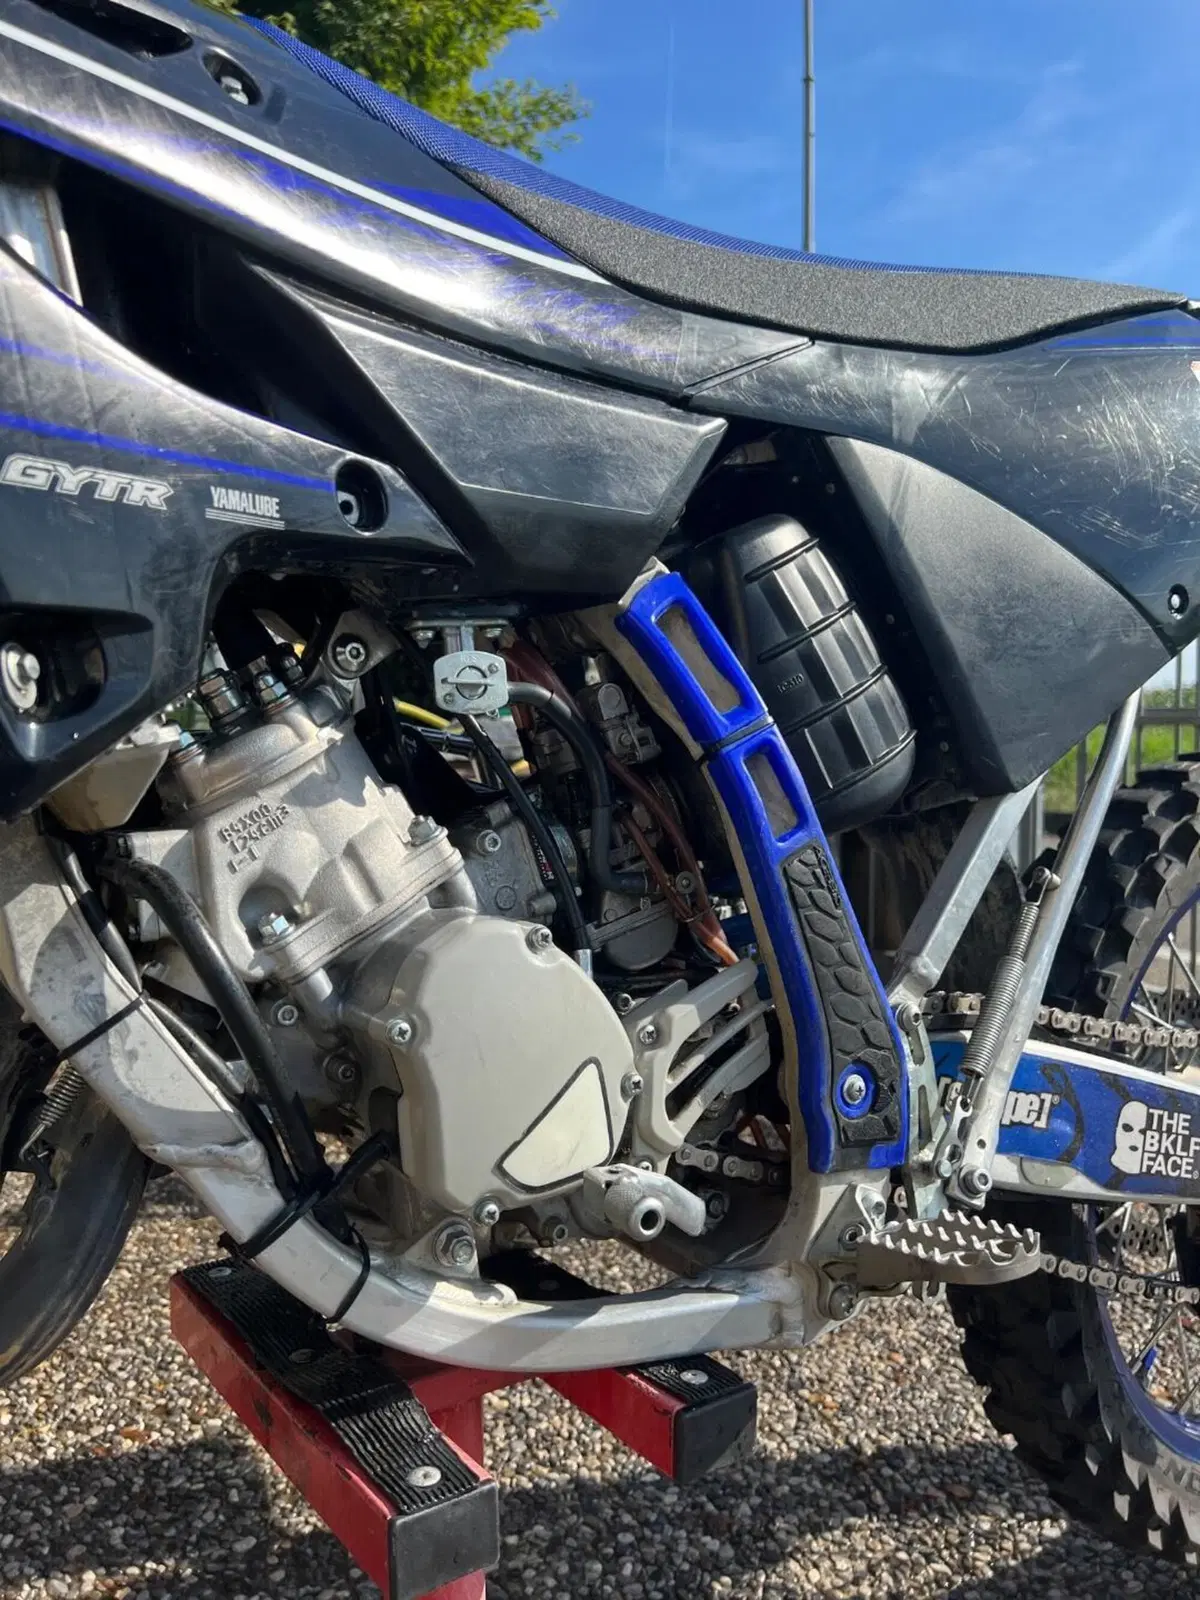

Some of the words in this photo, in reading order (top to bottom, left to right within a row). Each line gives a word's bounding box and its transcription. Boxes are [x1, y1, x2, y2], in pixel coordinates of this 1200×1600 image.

[0, 453, 174, 510] GYTR
[209, 485, 281, 519] YAMALUBE
[1148, 1108, 1191, 1135] THE
[1141, 1152, 1194, 1179] FACE
